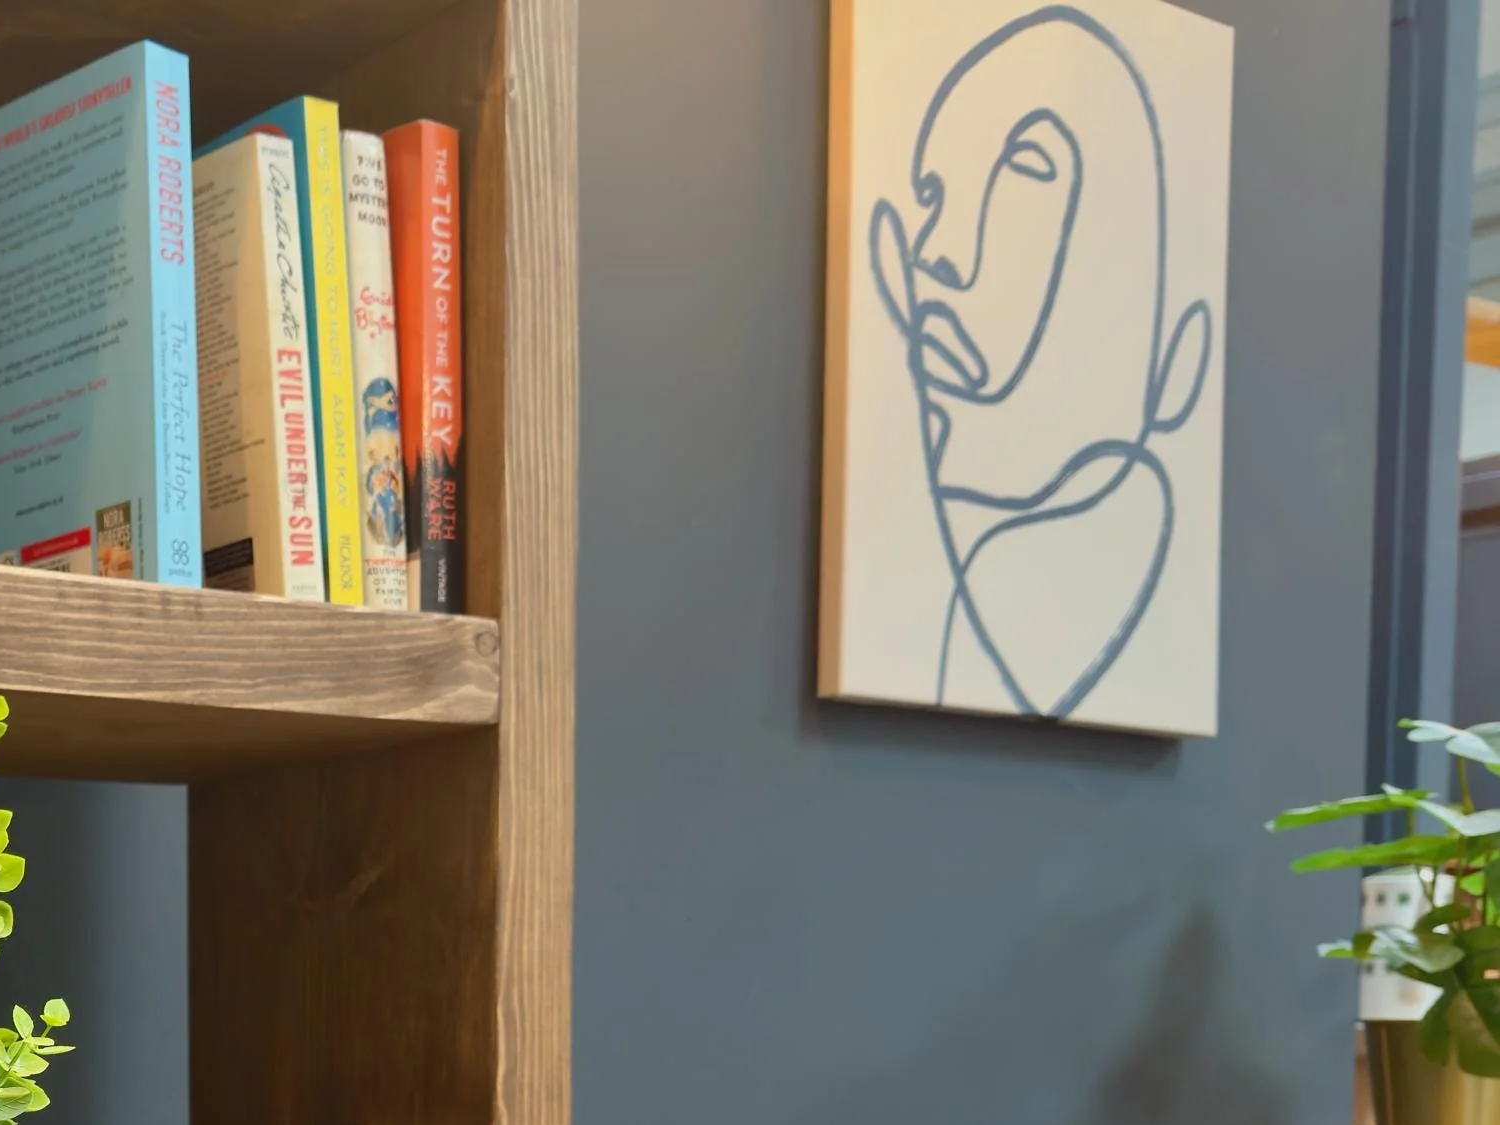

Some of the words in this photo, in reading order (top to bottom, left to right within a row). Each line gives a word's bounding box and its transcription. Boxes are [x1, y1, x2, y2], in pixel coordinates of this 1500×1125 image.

[155, 81, 181, 147] NORA
[434, 148, 448, 187] THE
[157, 154, 185, 266] ROBERTS
[323, 205, 336, 277] GOING
[430, 193, 452, 292] TURN
[327, 286, 339, 313] TO
[435, 297, 448, 321] OF
[171, 321, 188, 361] The
[328, 321, 343, 377] HURT
[435, 326, 449, 369] THE
[173, 372, 190, 444] Perfect
[277, 349, 304, 408] EVIL
[333, 394, 347, 459] ADAM
[431, 374, 453, 446] KEY
[284, 412, 308, 485] UNDER
[174, 452, 192, 512] Hope
[290, 486, 307, 511] THE
[336, 465, 349, 509] KAY
[428, 477, 443, 541] WARE
[442, 481, 456, 540] RUTH
[288, 515, 315, 566] SUN
[340, 534, 354, 591] PICADOR
[436, 558, 447, 603] VINTAGE
